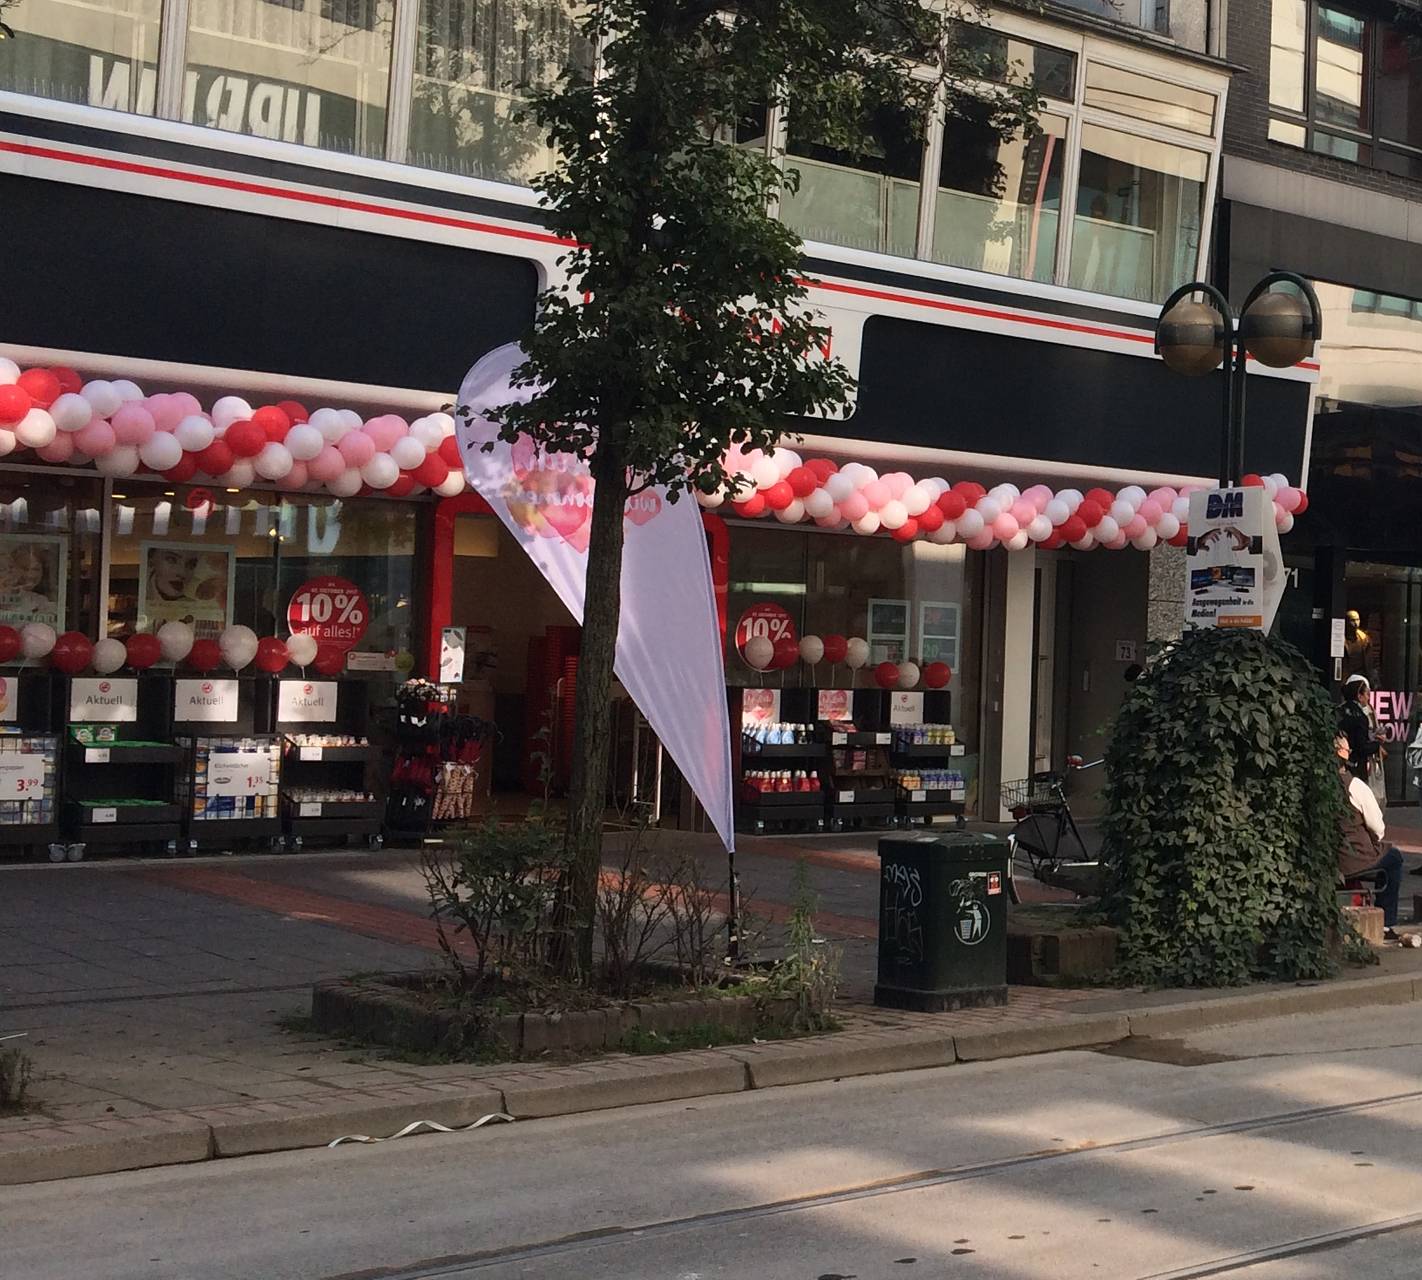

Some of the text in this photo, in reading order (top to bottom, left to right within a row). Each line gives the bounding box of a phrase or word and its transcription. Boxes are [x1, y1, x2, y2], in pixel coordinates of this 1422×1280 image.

[1206, 492, 1244, 519] DM
[297, 593, 363, 625] 10%
[300, 625, 321, 637] auf
[742, 617, 791, 642] 10%
[85, 695, 123, 705] Aktuell
[189, 695, 224, 706] Aktuell
[291, 696, 324, 707] Aktuell
[16, 779, 39, 792] 3.99
